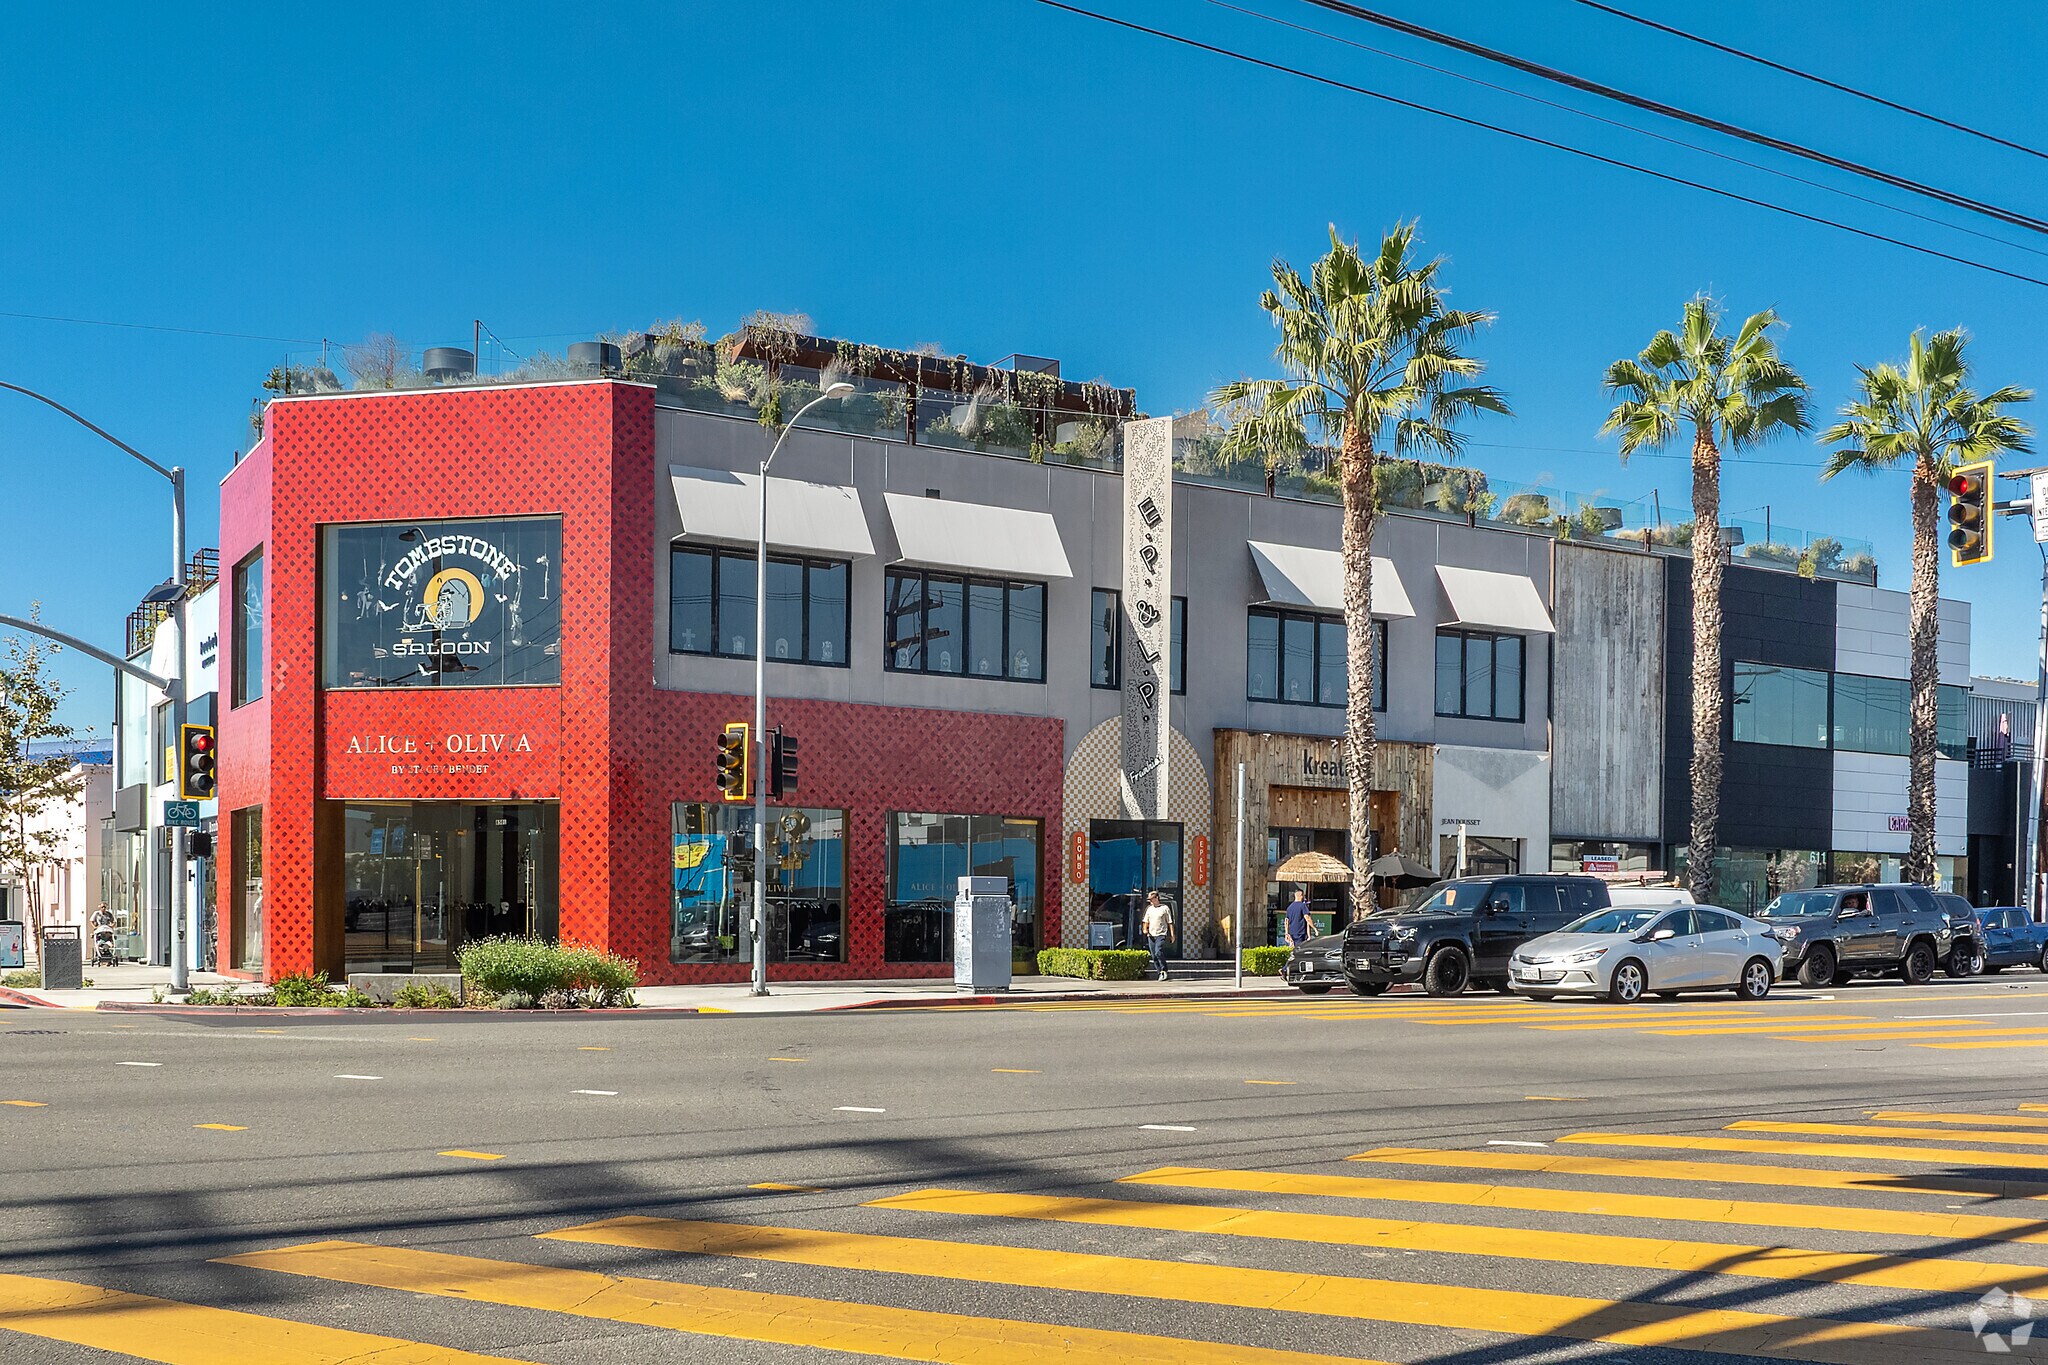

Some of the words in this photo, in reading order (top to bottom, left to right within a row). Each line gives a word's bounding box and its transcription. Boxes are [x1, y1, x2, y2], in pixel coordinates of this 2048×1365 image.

[384, 535, 517, 592] TOMBSTONE
[1136, 600, 1161, 628] &
[392, 641, 492, 656] SALOON
[346, 735, 418, 754] ALICE
[446, 733, 533, 753] OLIVIA
[391, 765, 405, 774] BY
[448, 764, 489, 774] BENDET
[1303, 749, 1349, 777] kreat
[1441, 818, 1455, 826] JEAN
[1455, 818, 1481, 826] DOUSSET
[1889, 816, 1911, 831] CARR
[1809, 851, 1826, 865] 611
[765, 884, 794, 893] LIVIA
